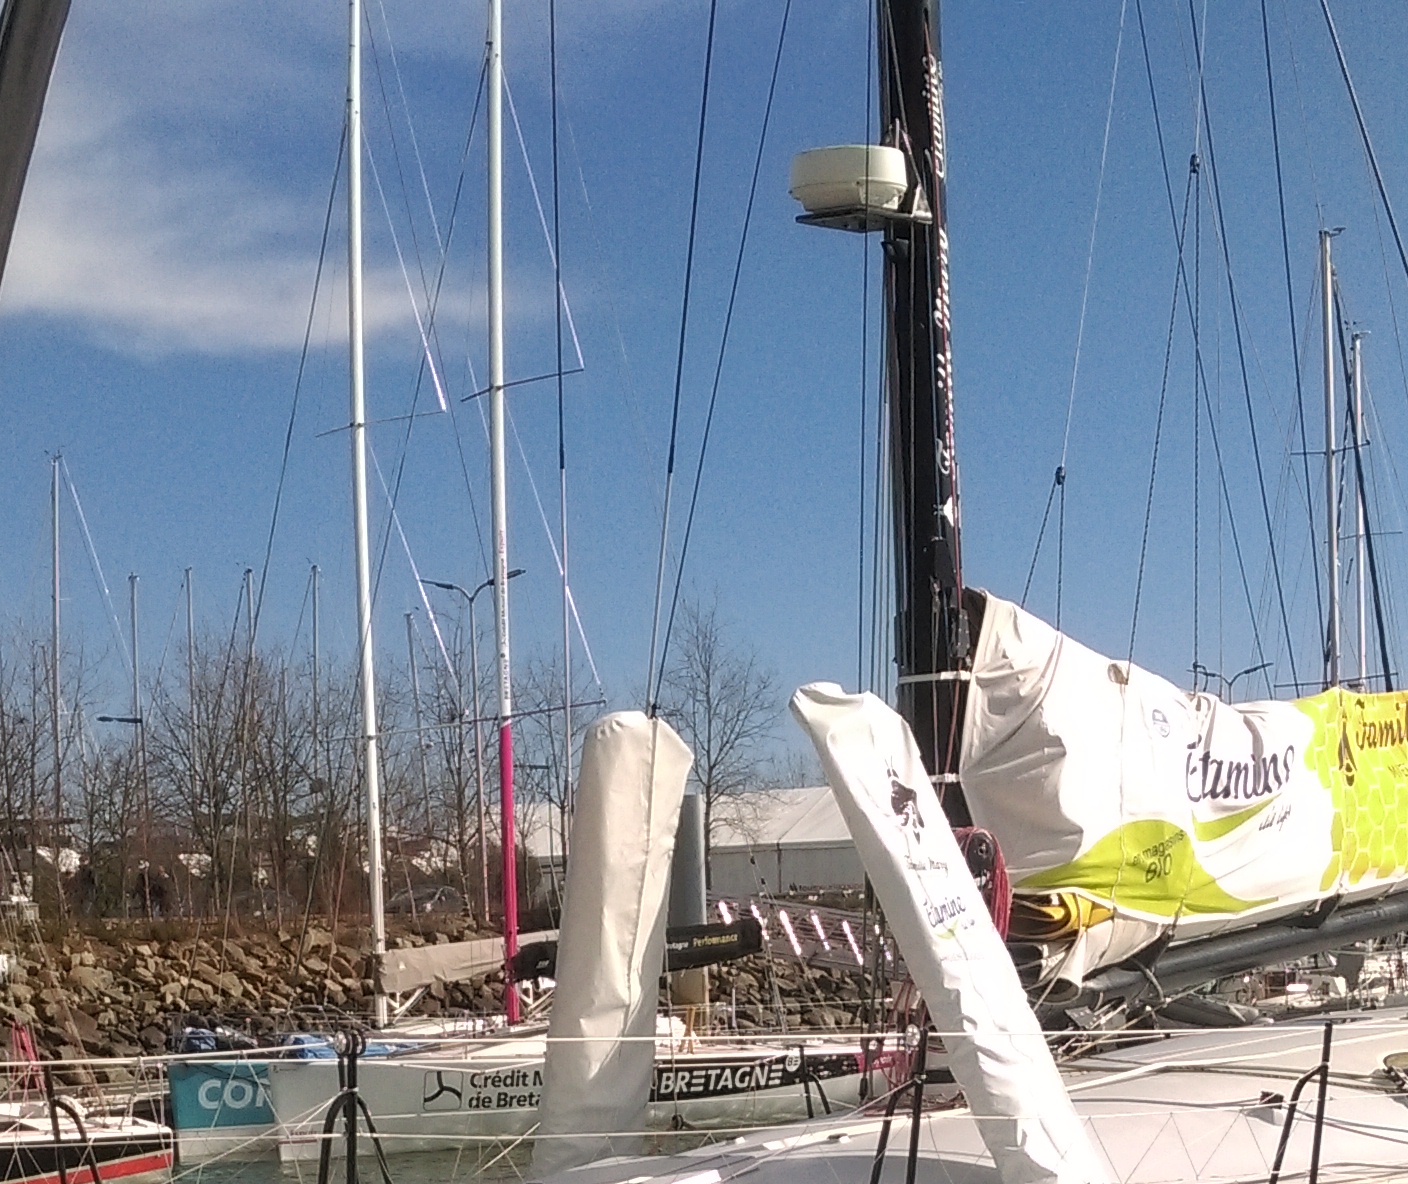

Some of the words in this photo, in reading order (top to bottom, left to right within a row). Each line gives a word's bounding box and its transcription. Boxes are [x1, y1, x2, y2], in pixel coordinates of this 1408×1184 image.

[1145, 853, 1172, 883] BIO
[470, 1070, 529, 1089] Crédit
[659, 1064, 783, 1094] BRETAGNE
[468, 1091, 492, 1109] de
